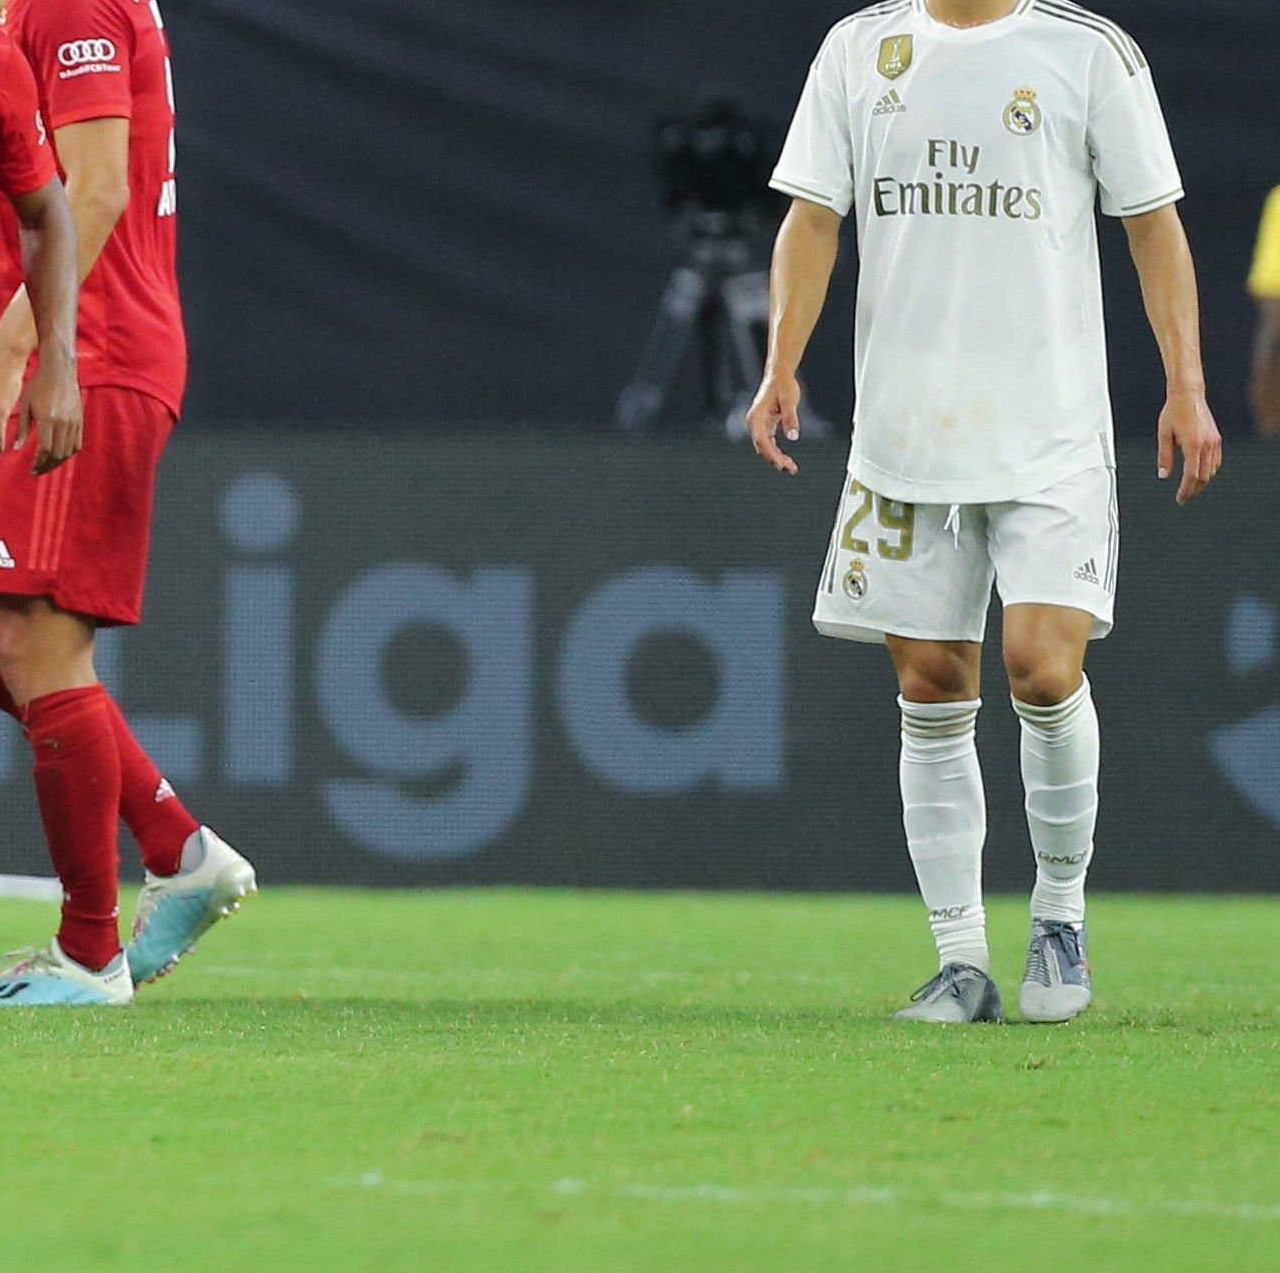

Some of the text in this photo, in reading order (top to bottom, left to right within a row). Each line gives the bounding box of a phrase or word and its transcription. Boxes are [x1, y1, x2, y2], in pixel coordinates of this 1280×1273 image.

[927, 139, 980, 175] Fly
[873, 172, 1042, 220] Emirates
[839, 481, 915, 562] 29
